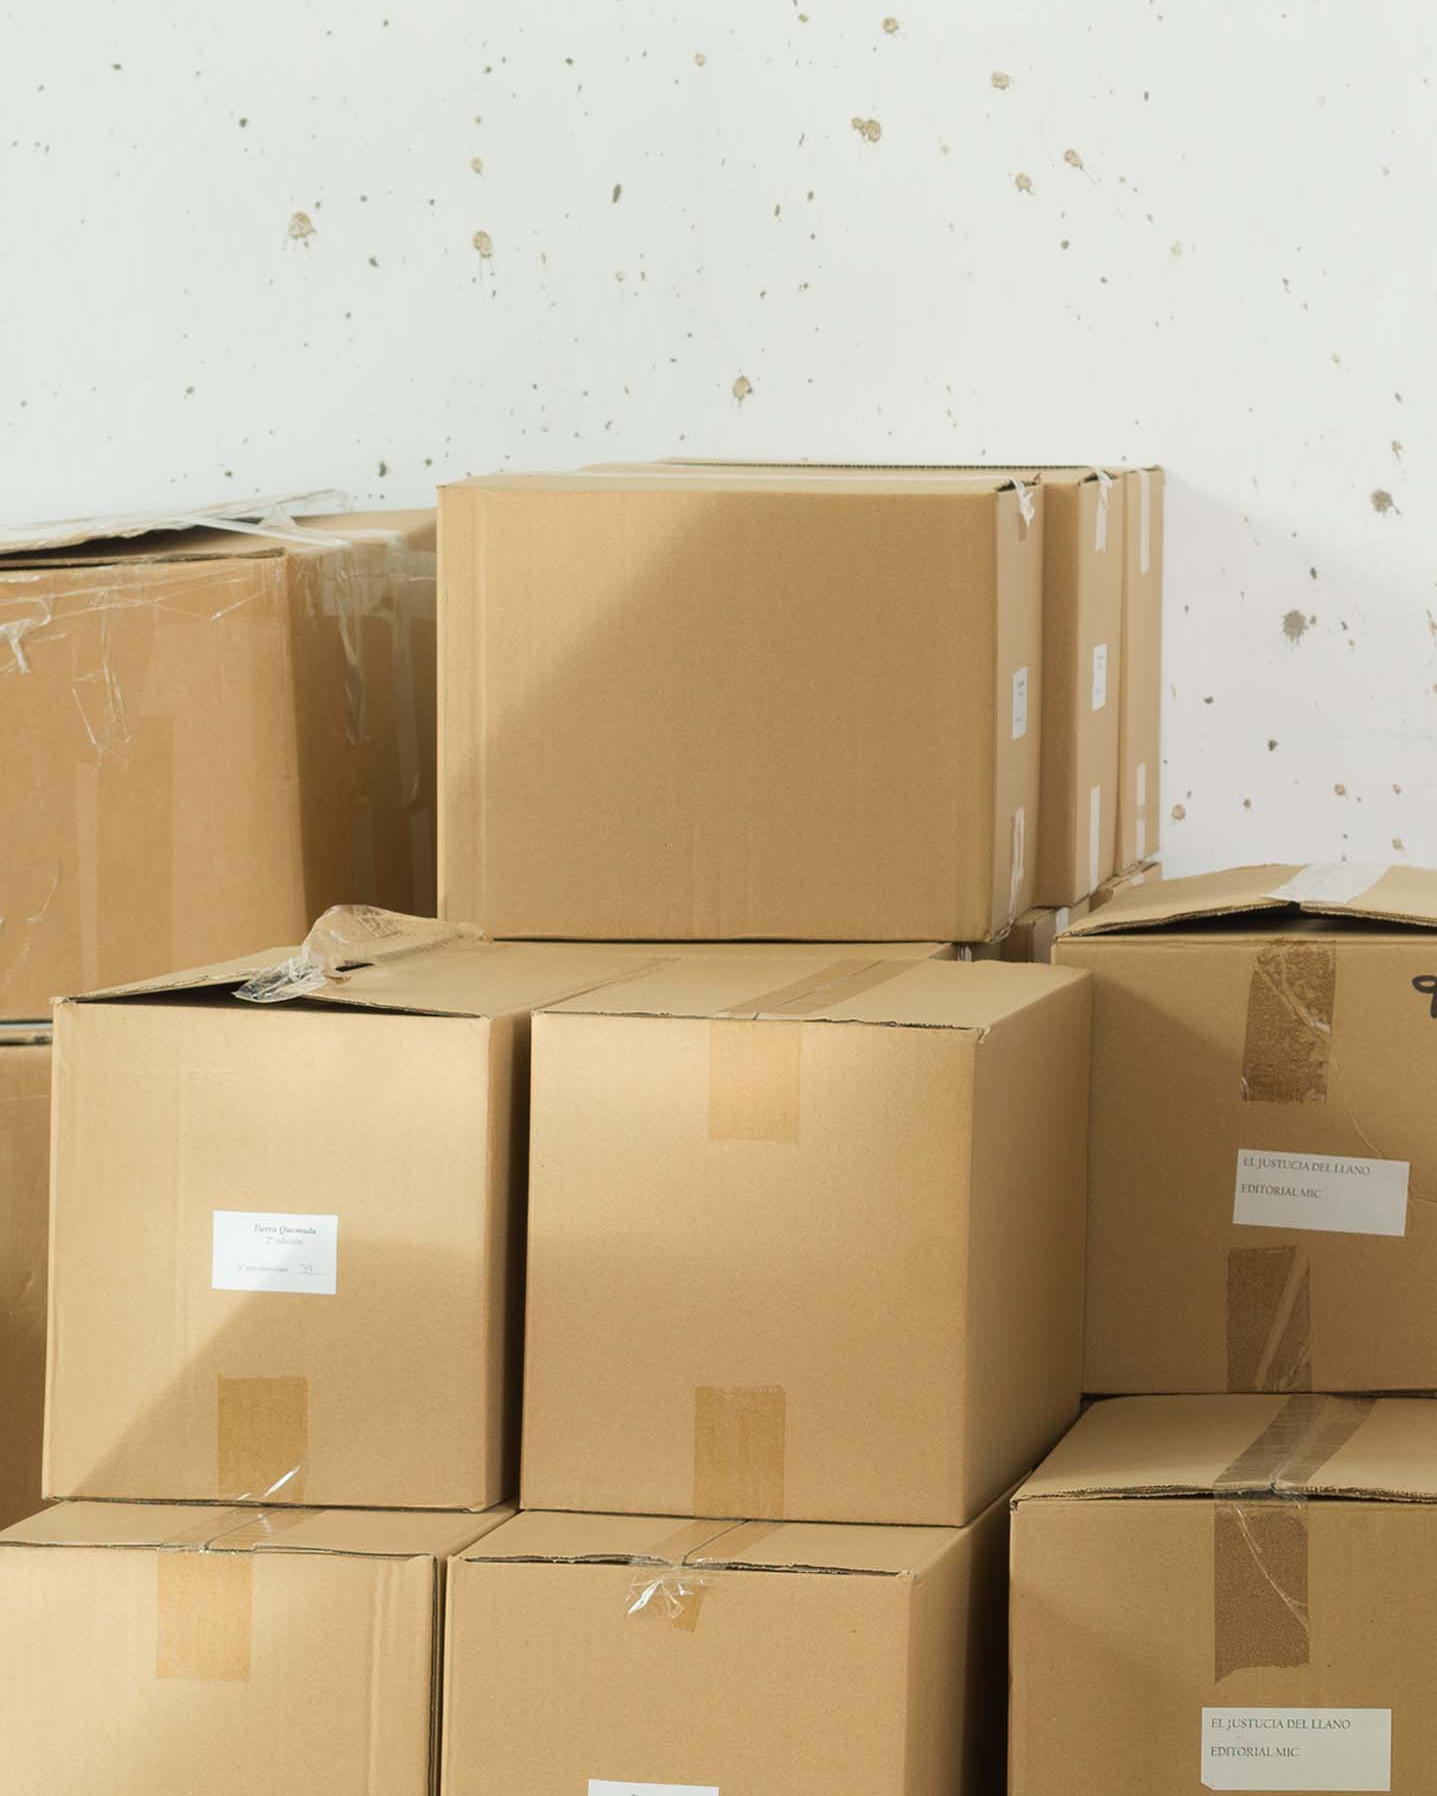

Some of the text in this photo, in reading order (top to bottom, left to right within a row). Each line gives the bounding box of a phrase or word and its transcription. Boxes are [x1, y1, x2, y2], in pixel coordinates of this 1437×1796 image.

[1243, 1156, 1256, 1167] EL
[1312, 1162, 1332, 1174] DEL
[1334, 1164, 1371, 1176] LLANO
[1241, 1183, 1321, 1198] EDITORIAL MIC
[1211, 1718, 1226, 1729] EL
[1287, 1718, 1310, 1730] DEL
[1311, 1719, 1351, 1730] LLANO
[1210, 1746, 1299, 1757] EDITORIAL MIC
